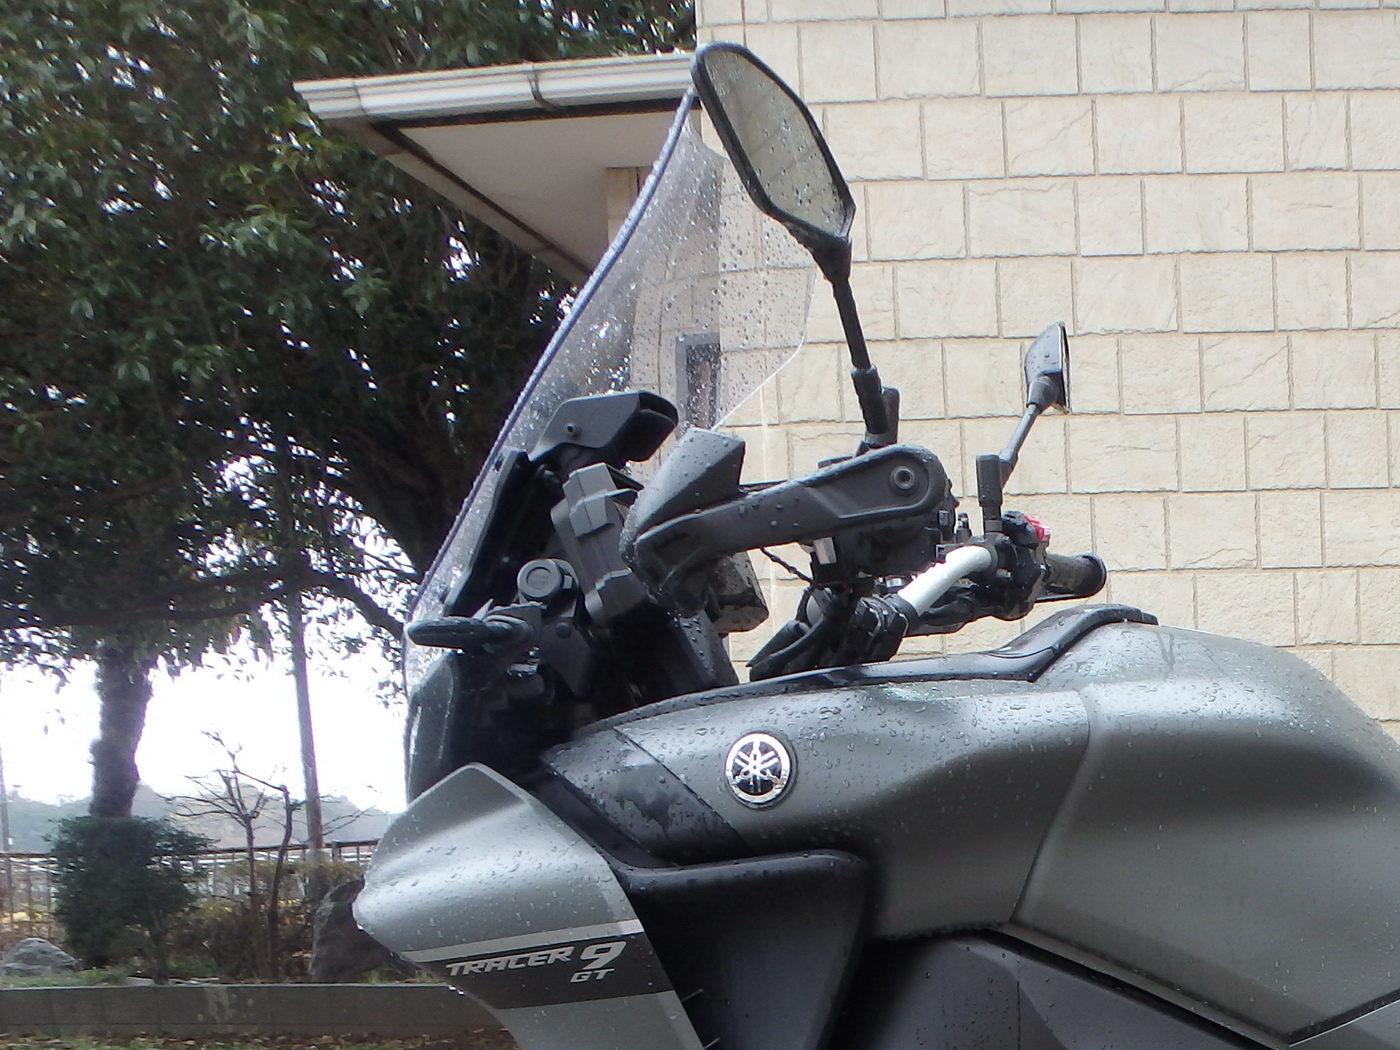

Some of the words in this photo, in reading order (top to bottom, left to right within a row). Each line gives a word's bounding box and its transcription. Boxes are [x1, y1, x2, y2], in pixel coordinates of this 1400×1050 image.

[446, 946, 574, 976] TRACER
[580, 941, 627, 970] 9
[570, 968, 615, 983] GT
